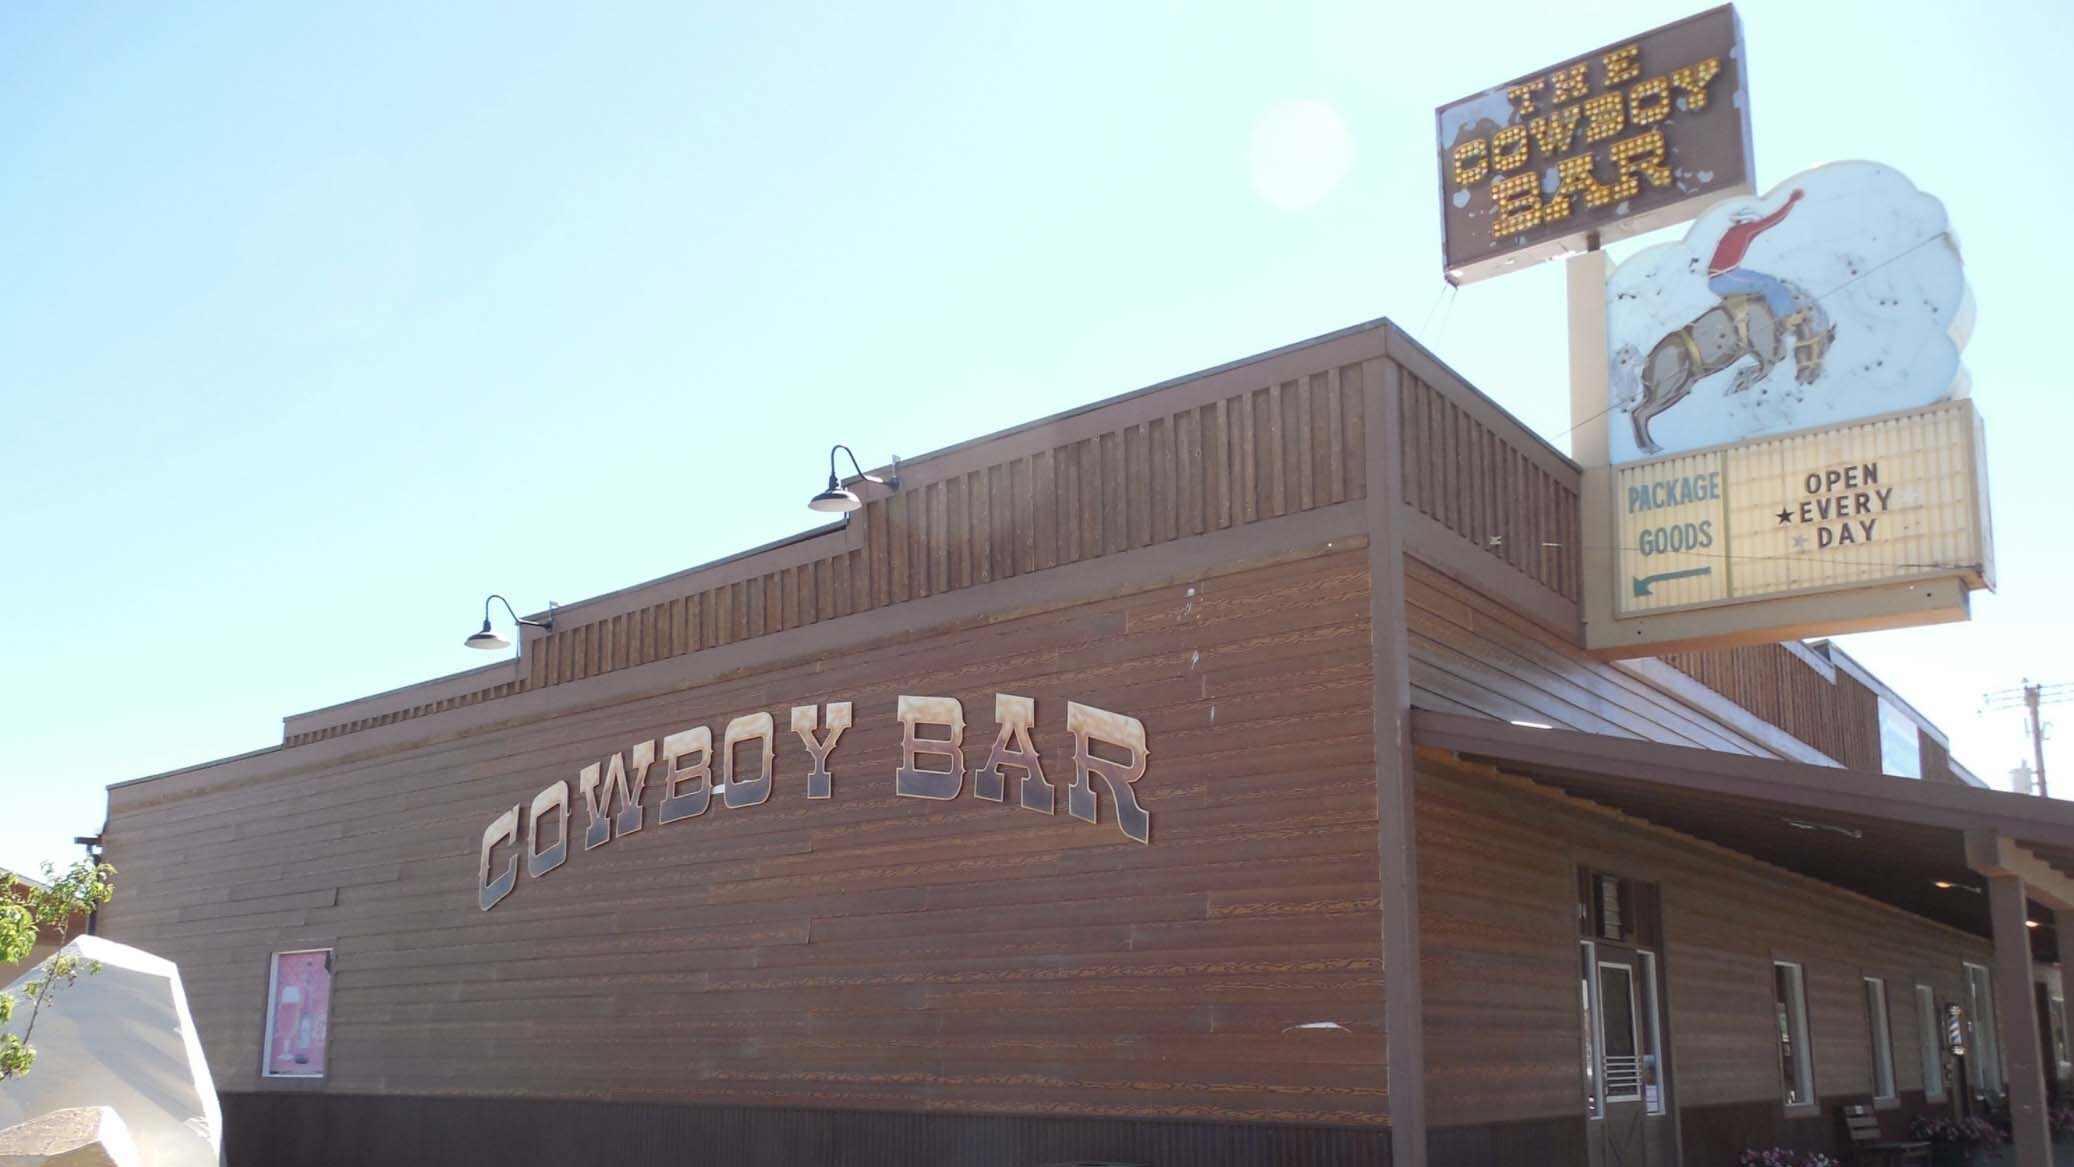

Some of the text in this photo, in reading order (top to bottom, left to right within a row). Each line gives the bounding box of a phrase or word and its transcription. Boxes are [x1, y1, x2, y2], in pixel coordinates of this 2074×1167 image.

[1507, 43, 1640, 115] THE
[1454, 56, 1721, 185] COWBOY
[1490, 130, 1673, 237] BAR
[1628, 471, 1720, 513] PACKAGE
[1805, 462, 1879, 494] OPEN
[1800, 487, 1893, 523] EVERY
[1639, 520, 1713, 556] GOODS
[1817, 518, 1877, 548] DAY
[478, 693, 1150, 911] COWBOY BAR
